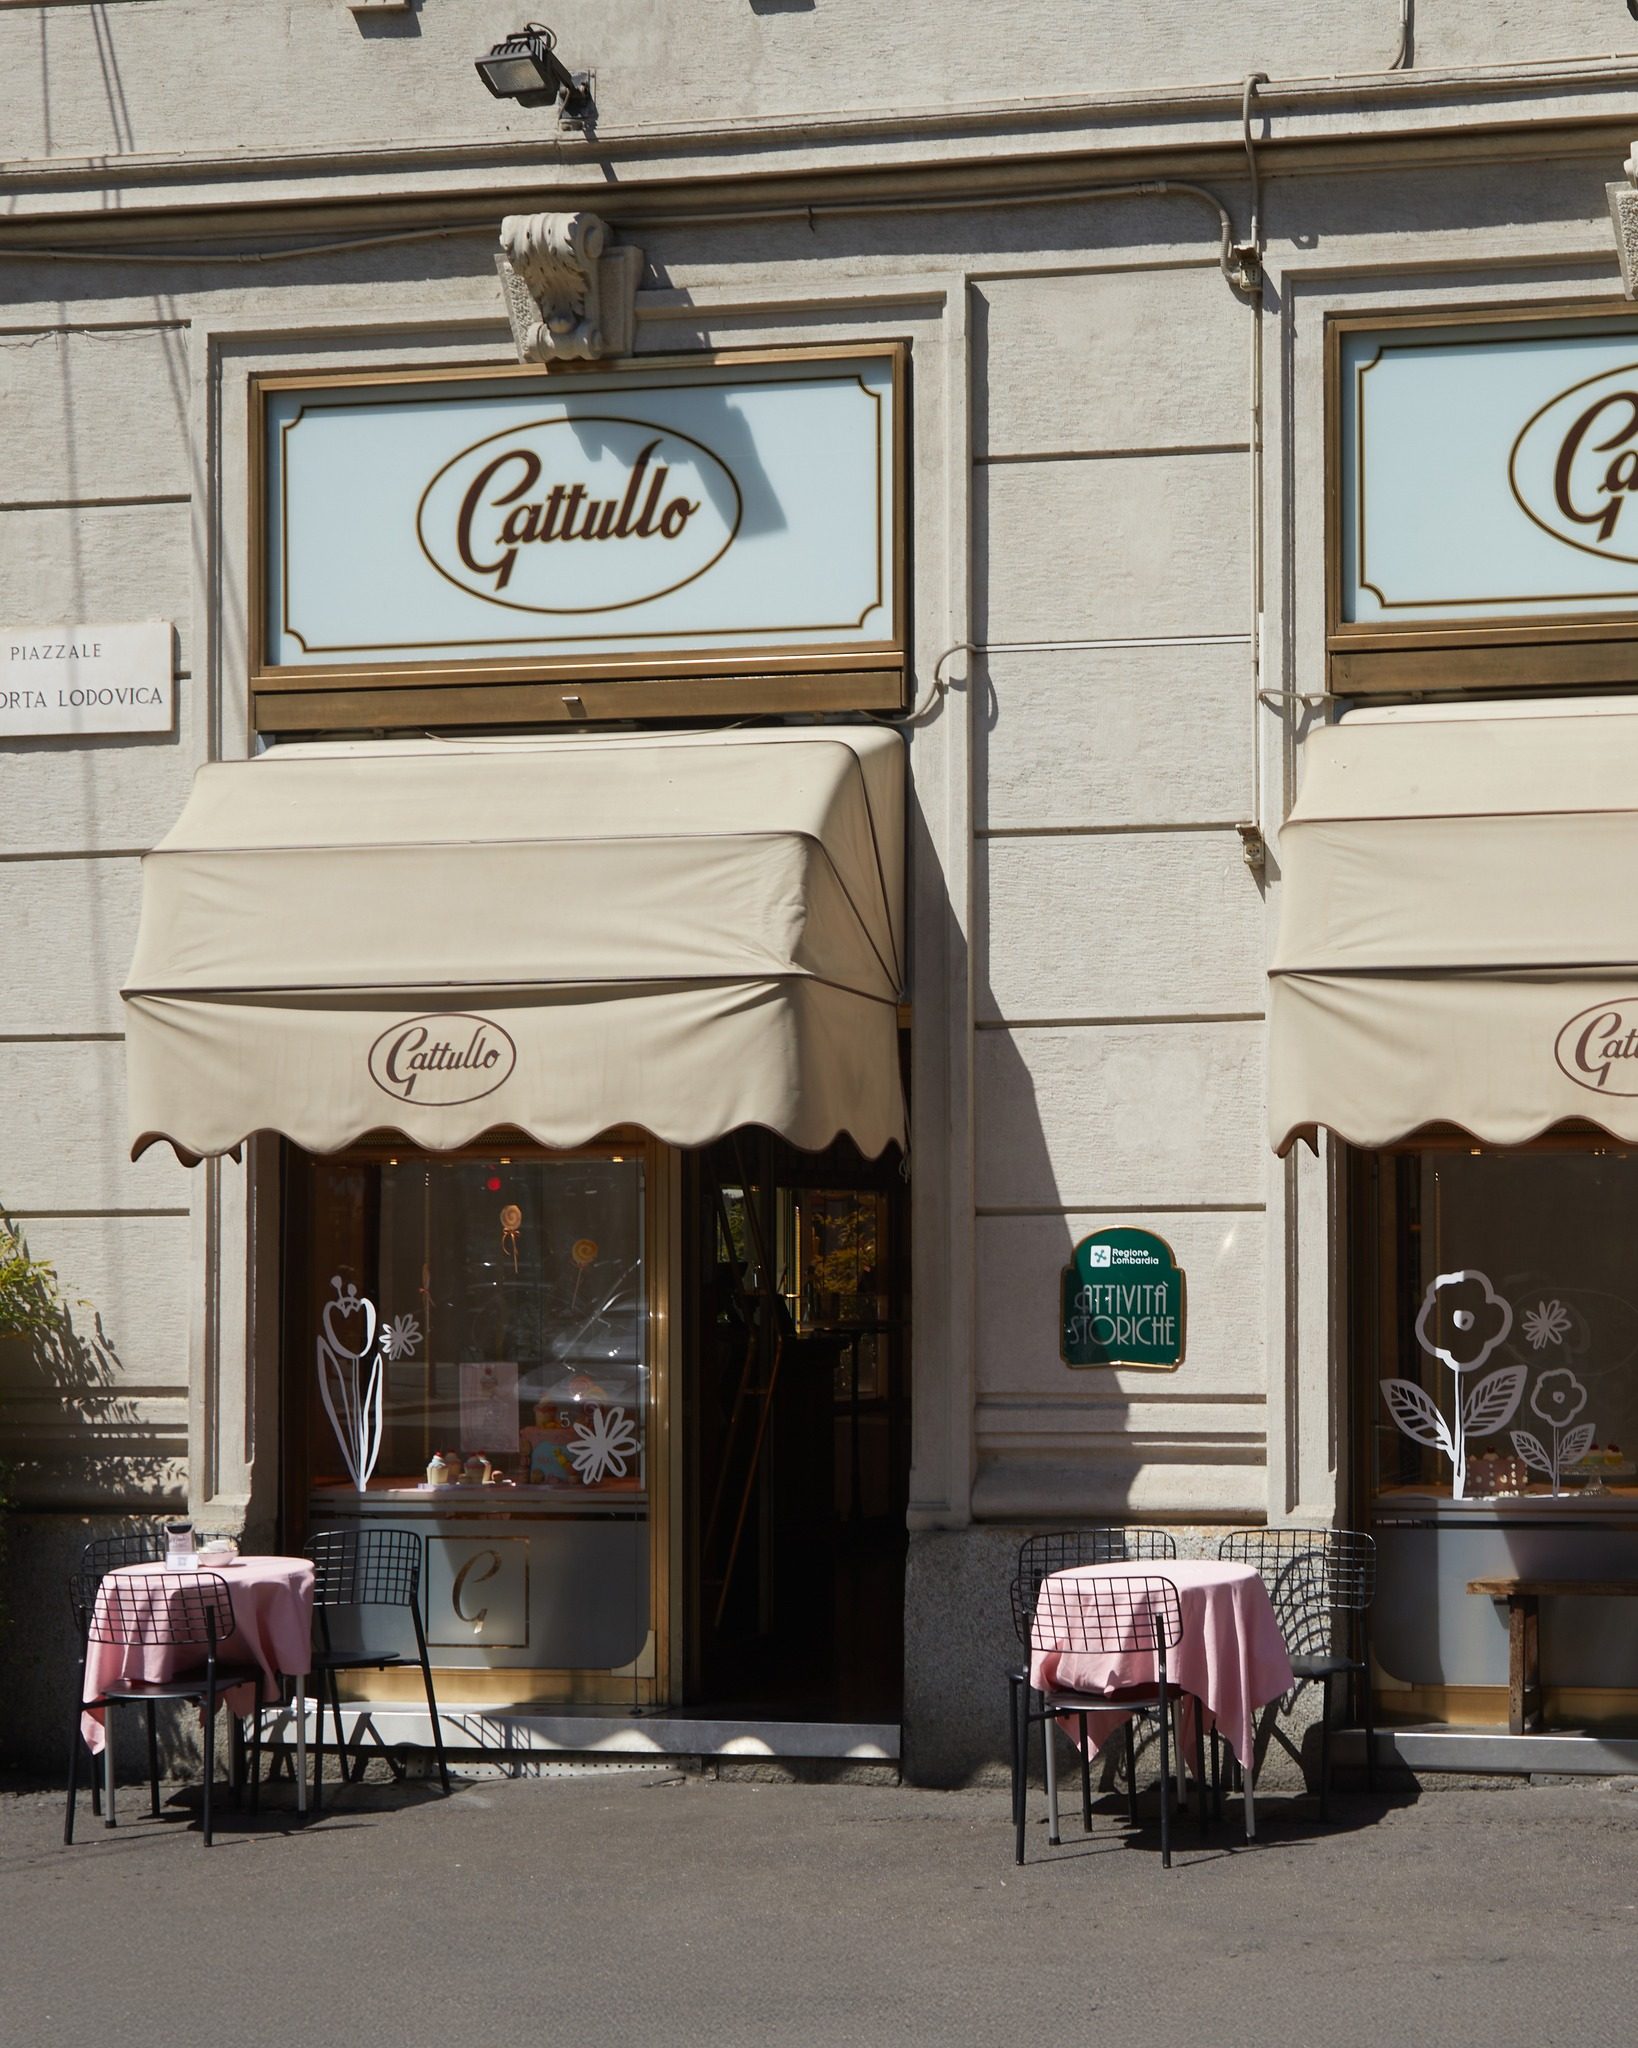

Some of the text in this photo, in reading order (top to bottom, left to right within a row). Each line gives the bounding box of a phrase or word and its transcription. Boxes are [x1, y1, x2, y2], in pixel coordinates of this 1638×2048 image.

[457, 438, 700, 591] Gattullo
[11, 644, 101, 661] PIAZZALE
[59, 687, 162, 707] LODOVICA
[386, 1025, 500, 1096] Gattullo
[1112, 1248, 1149, 1257] Regione
[1112, 1256, 1159, 1265] Lombardia
[1074, 1281, 1169, 1315] ATTIVITÀ
[1069, 1315, 1176, 1346] STORICHE
